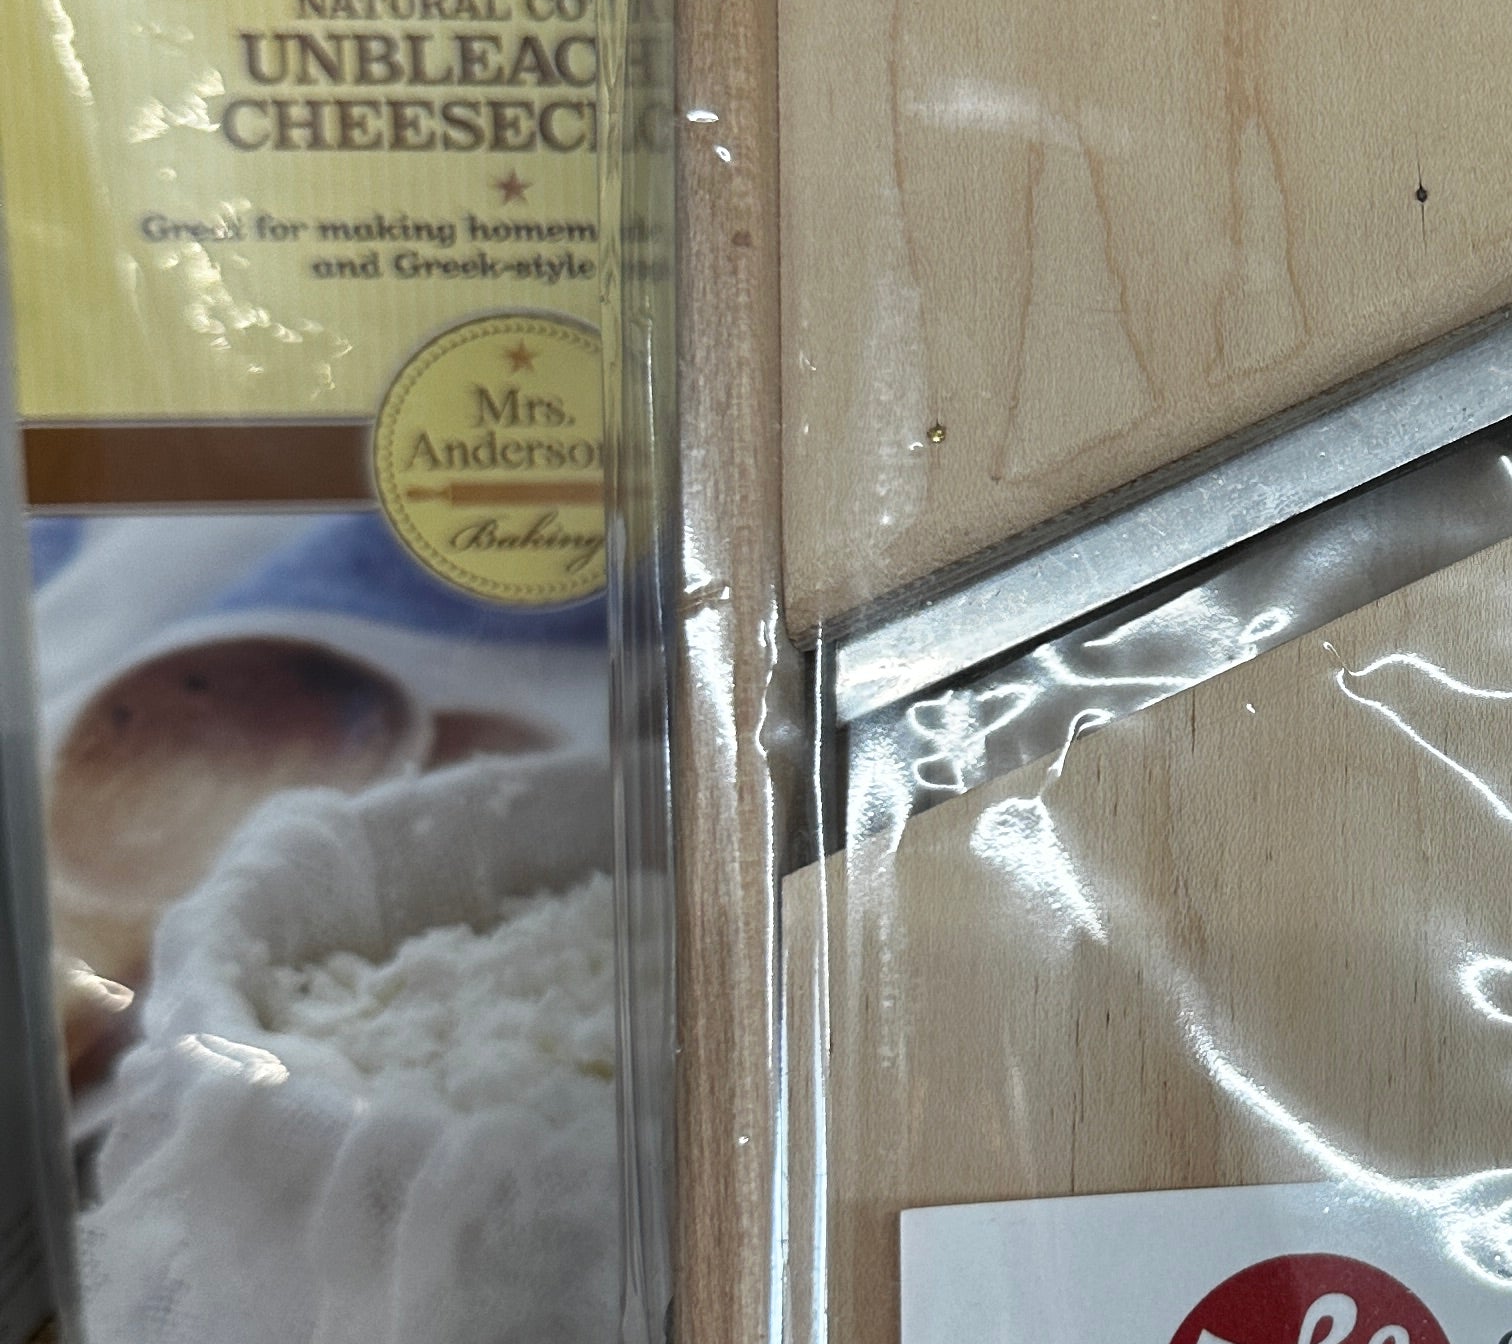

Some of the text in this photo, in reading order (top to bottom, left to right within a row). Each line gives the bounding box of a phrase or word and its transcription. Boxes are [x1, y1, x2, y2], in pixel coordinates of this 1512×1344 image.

[239, 32, 597, 88] UNBLEAC
[221, 98, 597, 154] CHEESEC
[256, 213, 307, 242] for
[319, 214, 457, 249] making
[469, 213, 598, 243] homem
[312, 251, 382, 280] and
[395, 250, 597, 284] Greek-style
[470, 384, 575, 427] Mrs.
[403, 430, 602, 471] Anderso
